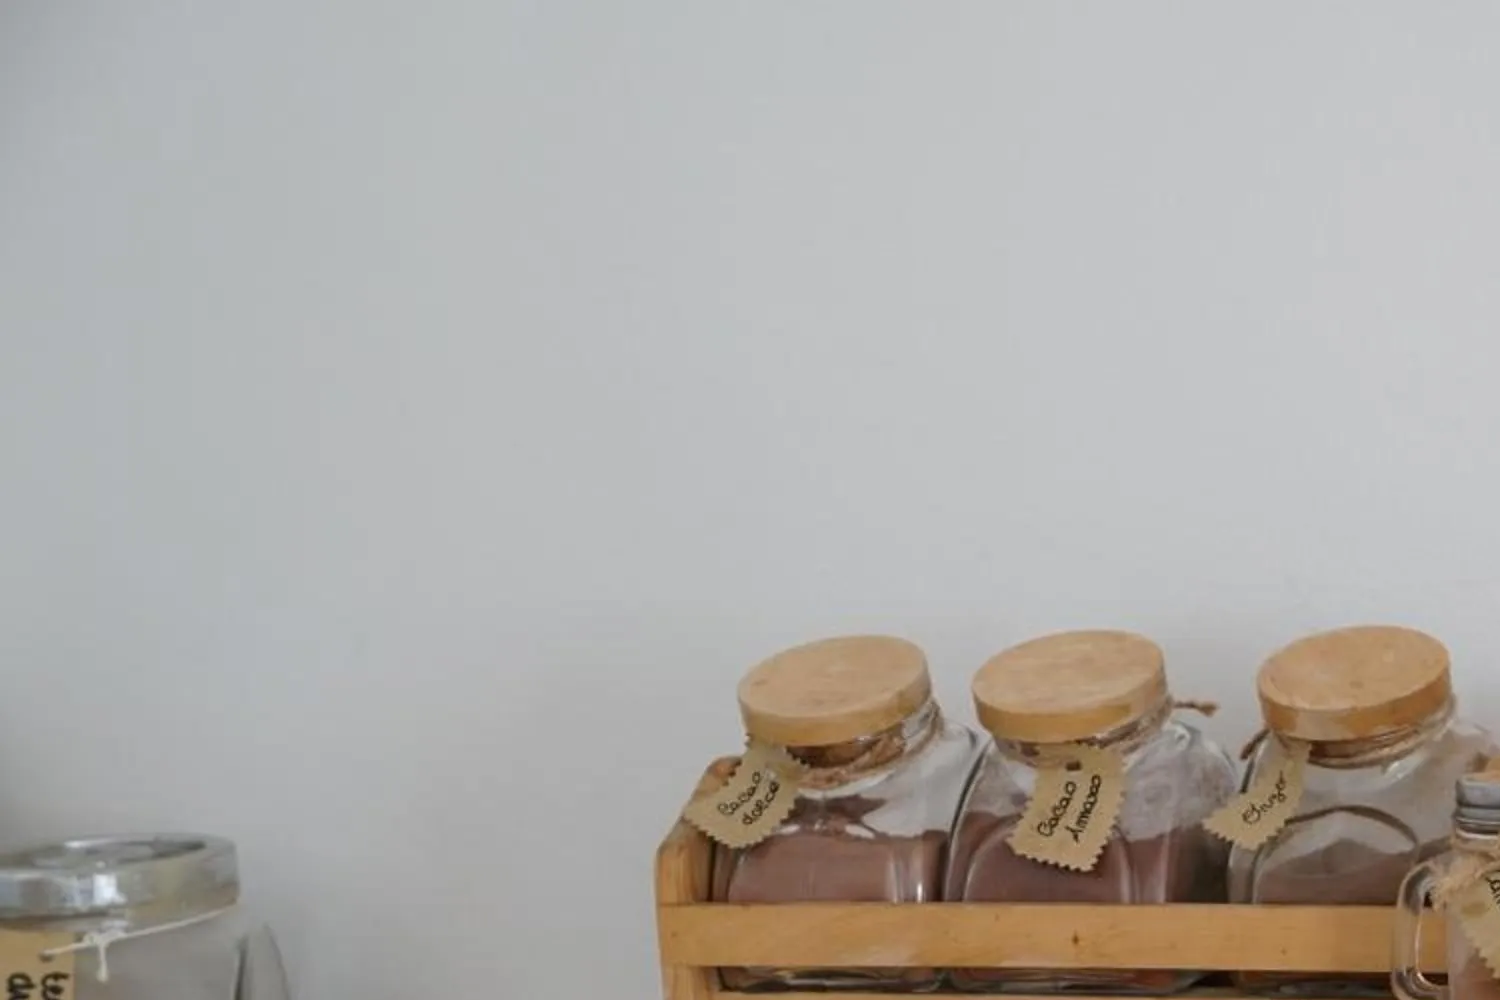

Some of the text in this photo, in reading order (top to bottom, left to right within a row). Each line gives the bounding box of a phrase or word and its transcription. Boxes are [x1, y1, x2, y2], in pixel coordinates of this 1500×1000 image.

[717, 771, 762, 817] Cacao
[742, 780, 781, 825] dolce
[1037, 780, 1077, 838] Cacao
